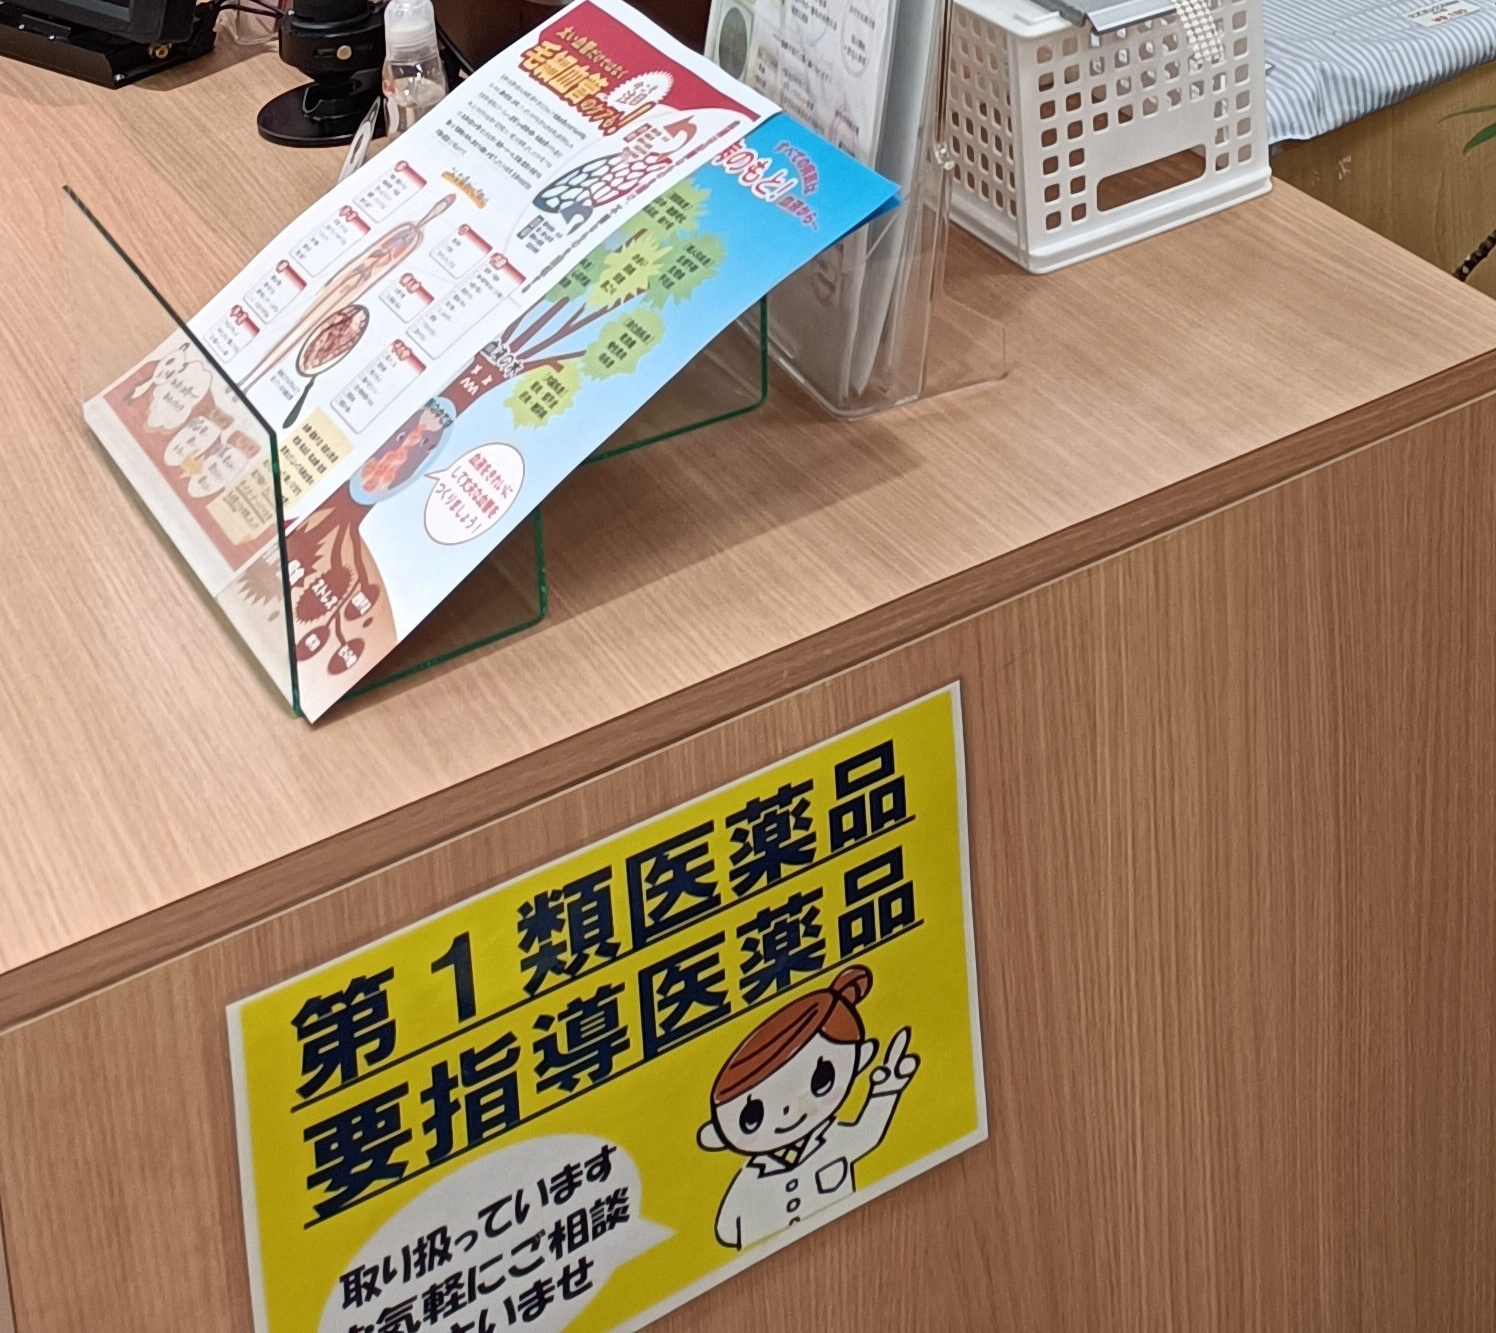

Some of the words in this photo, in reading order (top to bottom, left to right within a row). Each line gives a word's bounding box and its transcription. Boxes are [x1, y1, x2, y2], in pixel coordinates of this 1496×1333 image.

[290, 737, 909, 1101] 第1類医薬品
[303, 846, 917, 1208] 要指導医薬品
[340, 1143, 621, 1311] 取り扱っています
